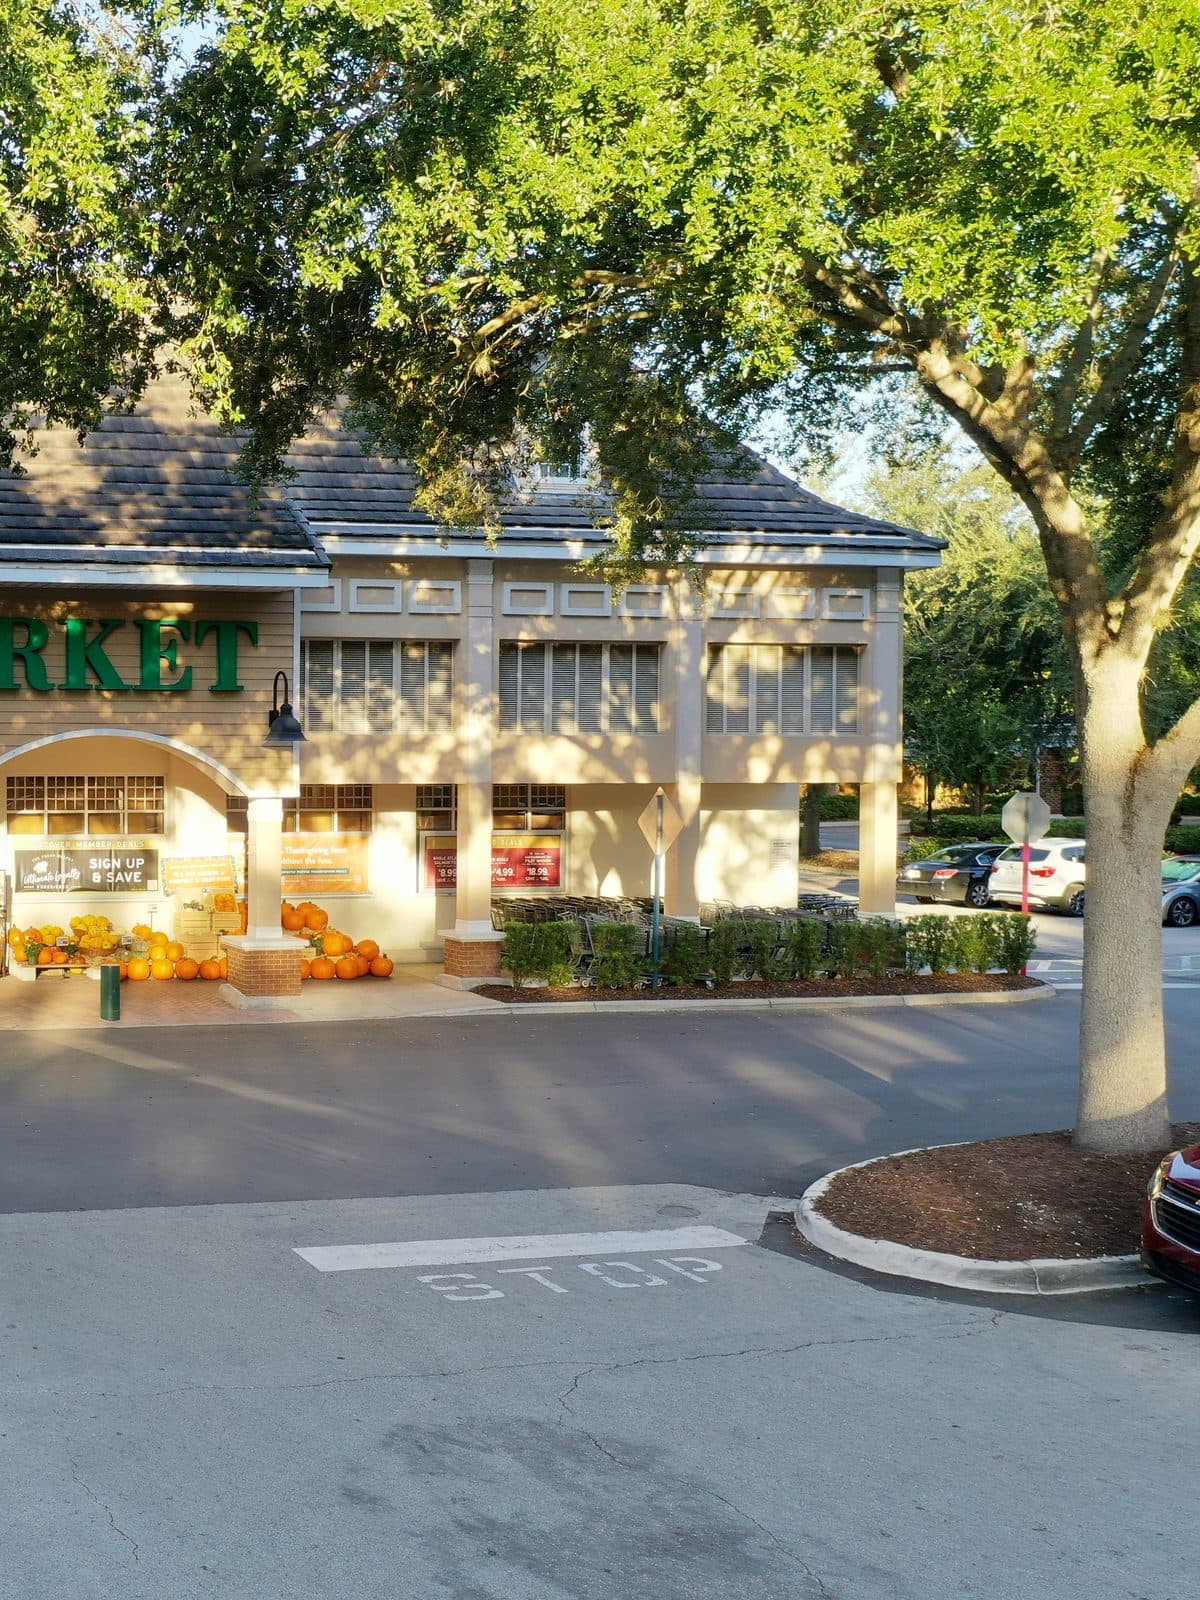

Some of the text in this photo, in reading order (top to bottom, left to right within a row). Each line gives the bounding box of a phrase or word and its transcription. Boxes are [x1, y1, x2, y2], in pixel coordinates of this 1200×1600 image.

[75, 840, 112, 848] MEMBER
[118, 840, 145, 848] DEALS
[89, 858, 145, 869] SIGN UP
[92, 872, 141, 883] & SAVE
[416, 1256, 723, 1301] STOP
